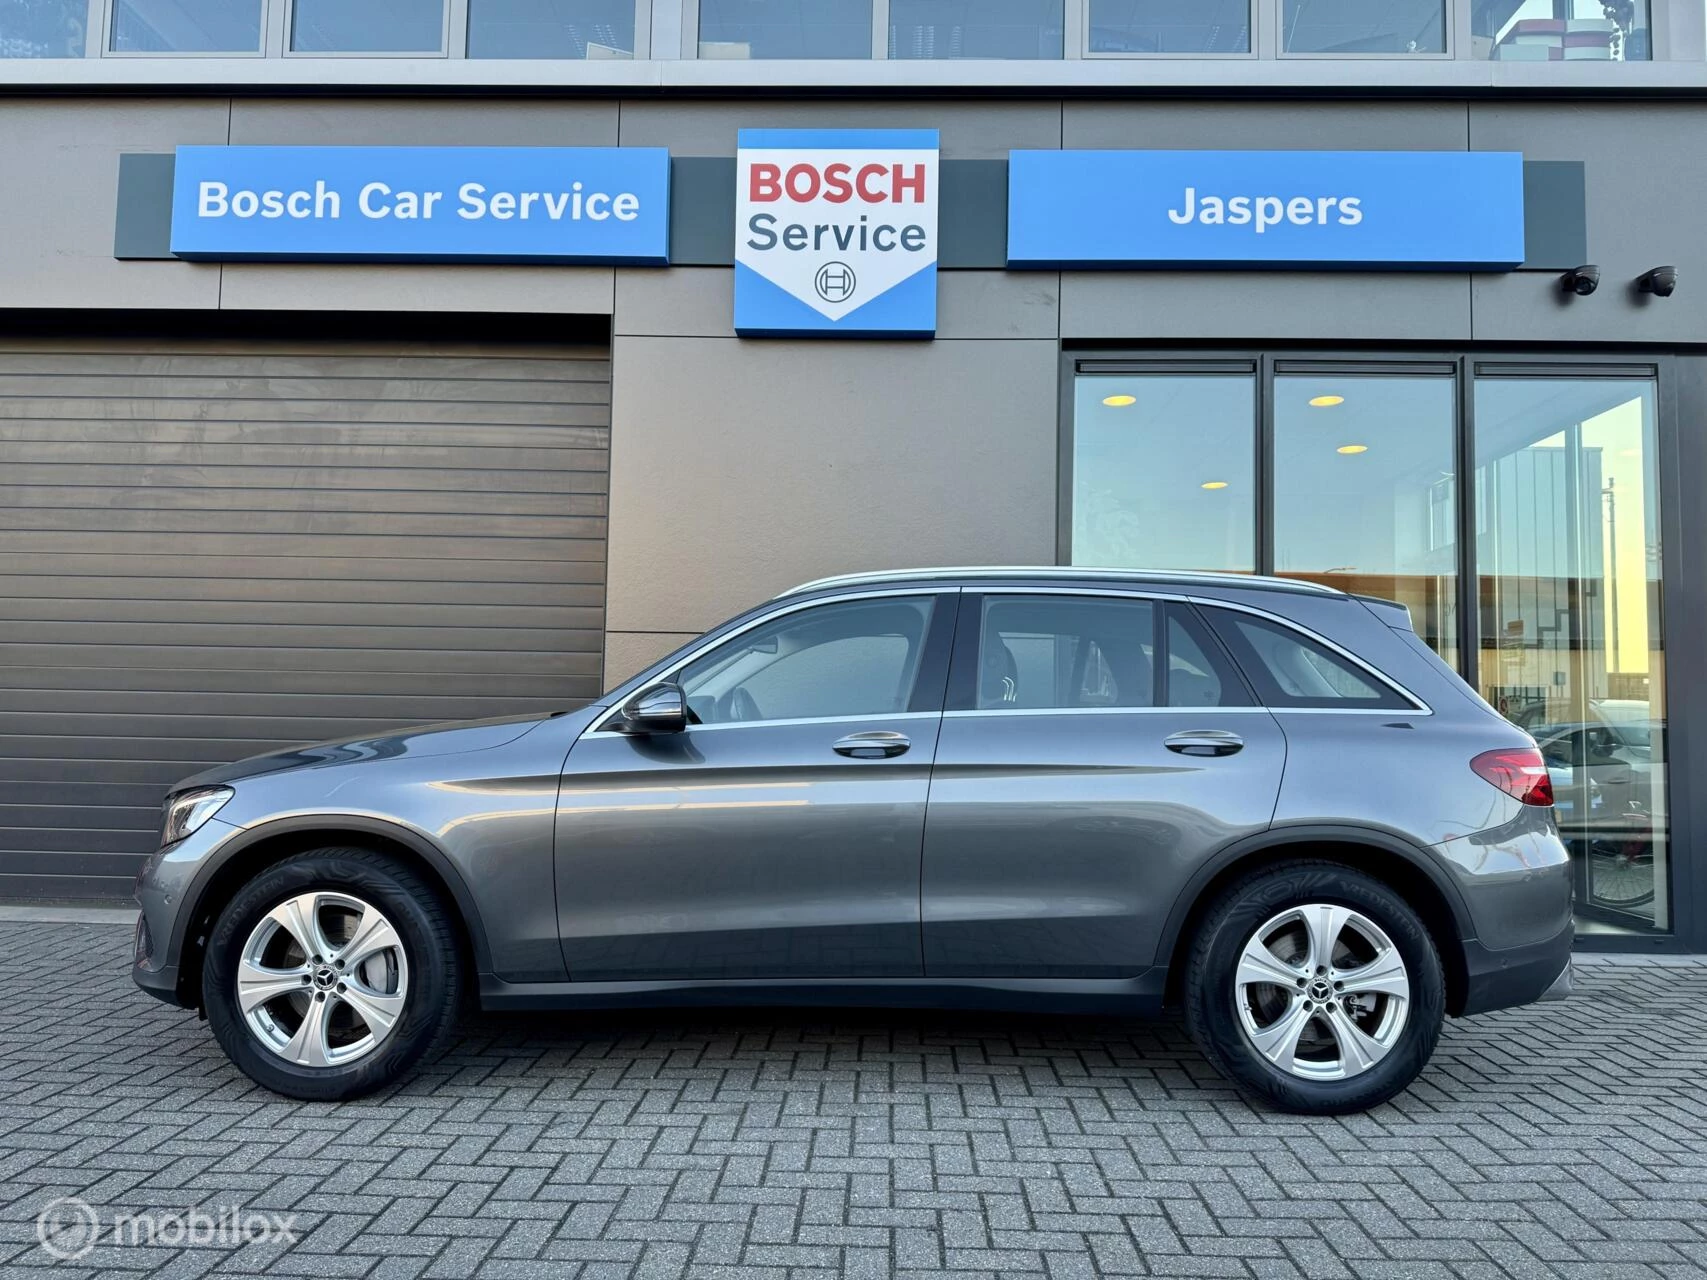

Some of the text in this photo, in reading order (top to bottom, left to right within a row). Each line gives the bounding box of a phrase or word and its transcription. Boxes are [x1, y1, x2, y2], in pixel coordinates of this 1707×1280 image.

[198, 181, 640, 221] Bosch Car Service
[750, 164, 925, 203] BOSCH
[1168, 187, 1363, 234] Jaspers
[747, 213, 926, 252] Service
